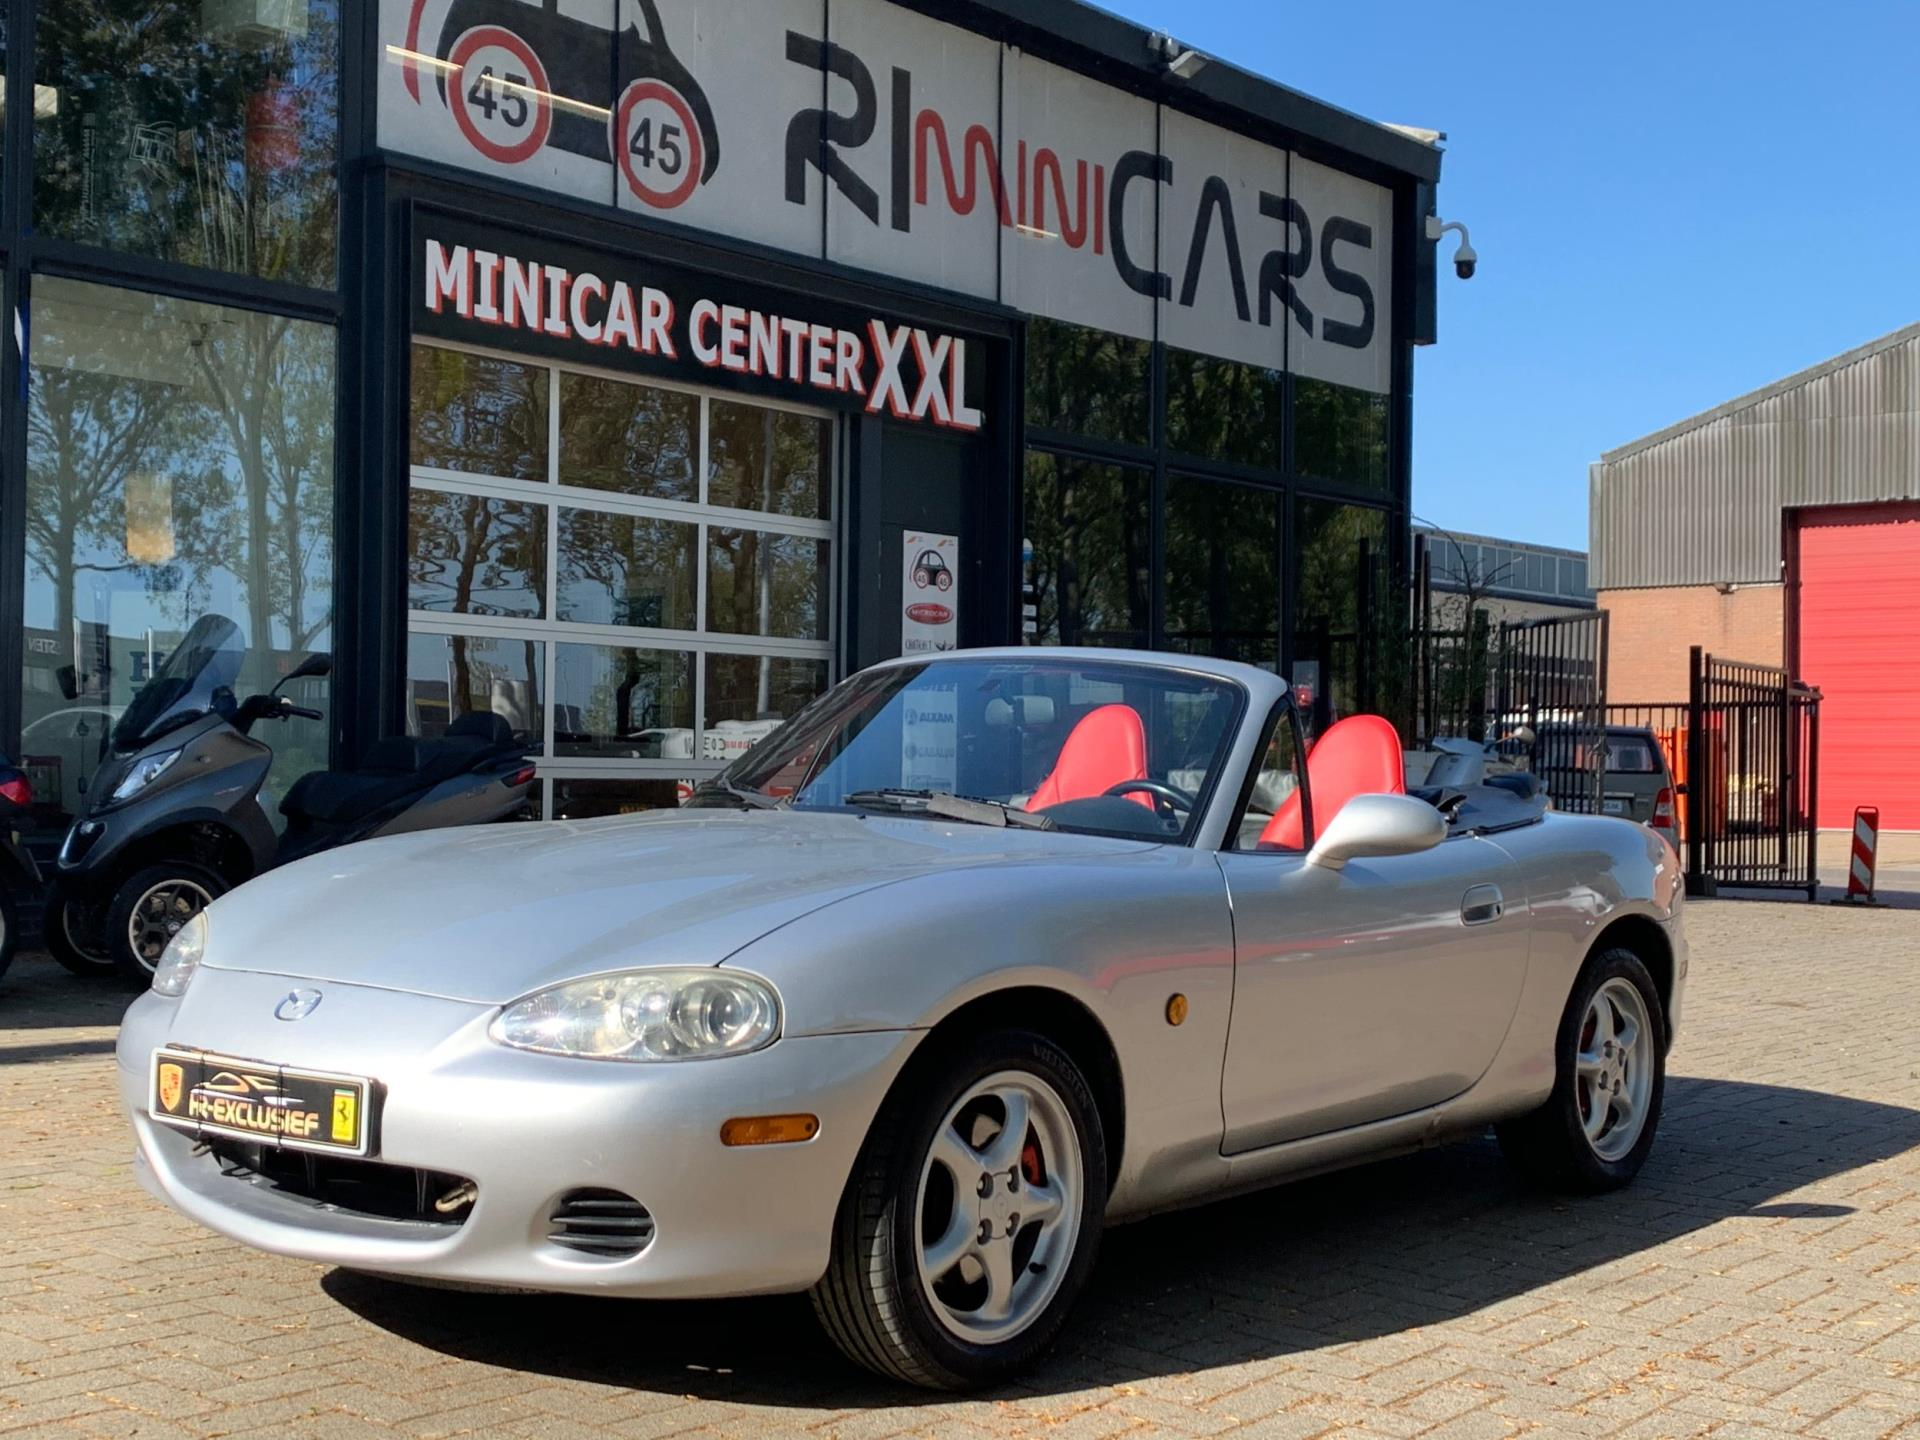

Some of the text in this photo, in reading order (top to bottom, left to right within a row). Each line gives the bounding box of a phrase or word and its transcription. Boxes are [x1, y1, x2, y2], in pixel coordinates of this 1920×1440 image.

[467, 63, 528, 128] 45
[629, 117, 682, 175] 45
[425, 238, 983, 431] MINICAR CENTER XXL
